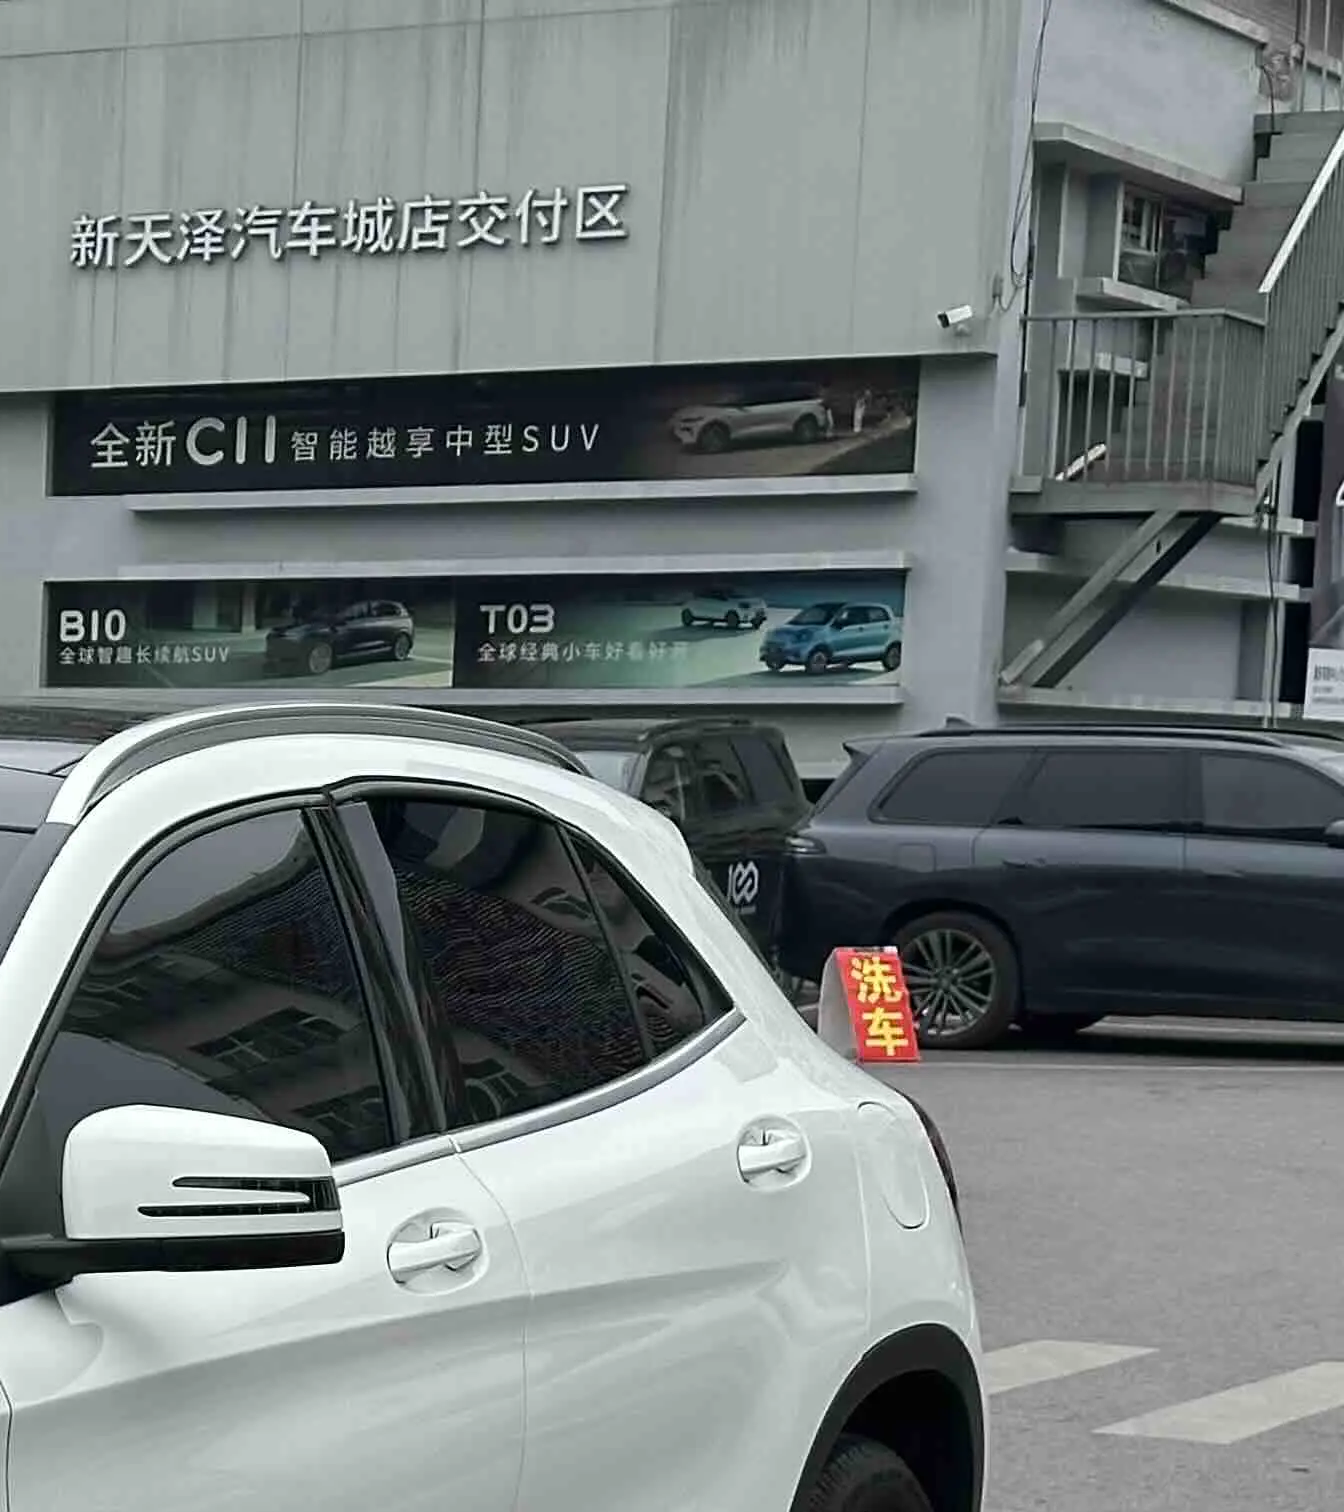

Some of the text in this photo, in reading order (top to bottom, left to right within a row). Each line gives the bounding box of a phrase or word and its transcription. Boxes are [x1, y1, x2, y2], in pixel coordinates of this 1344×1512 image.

[69, 183, 631, 269] 新天泽汽车城店交付区
[59, 608, 127, 643] B10
[478, 602, 556, 635] T03
[850, 955, 910, 1057] 洗车
